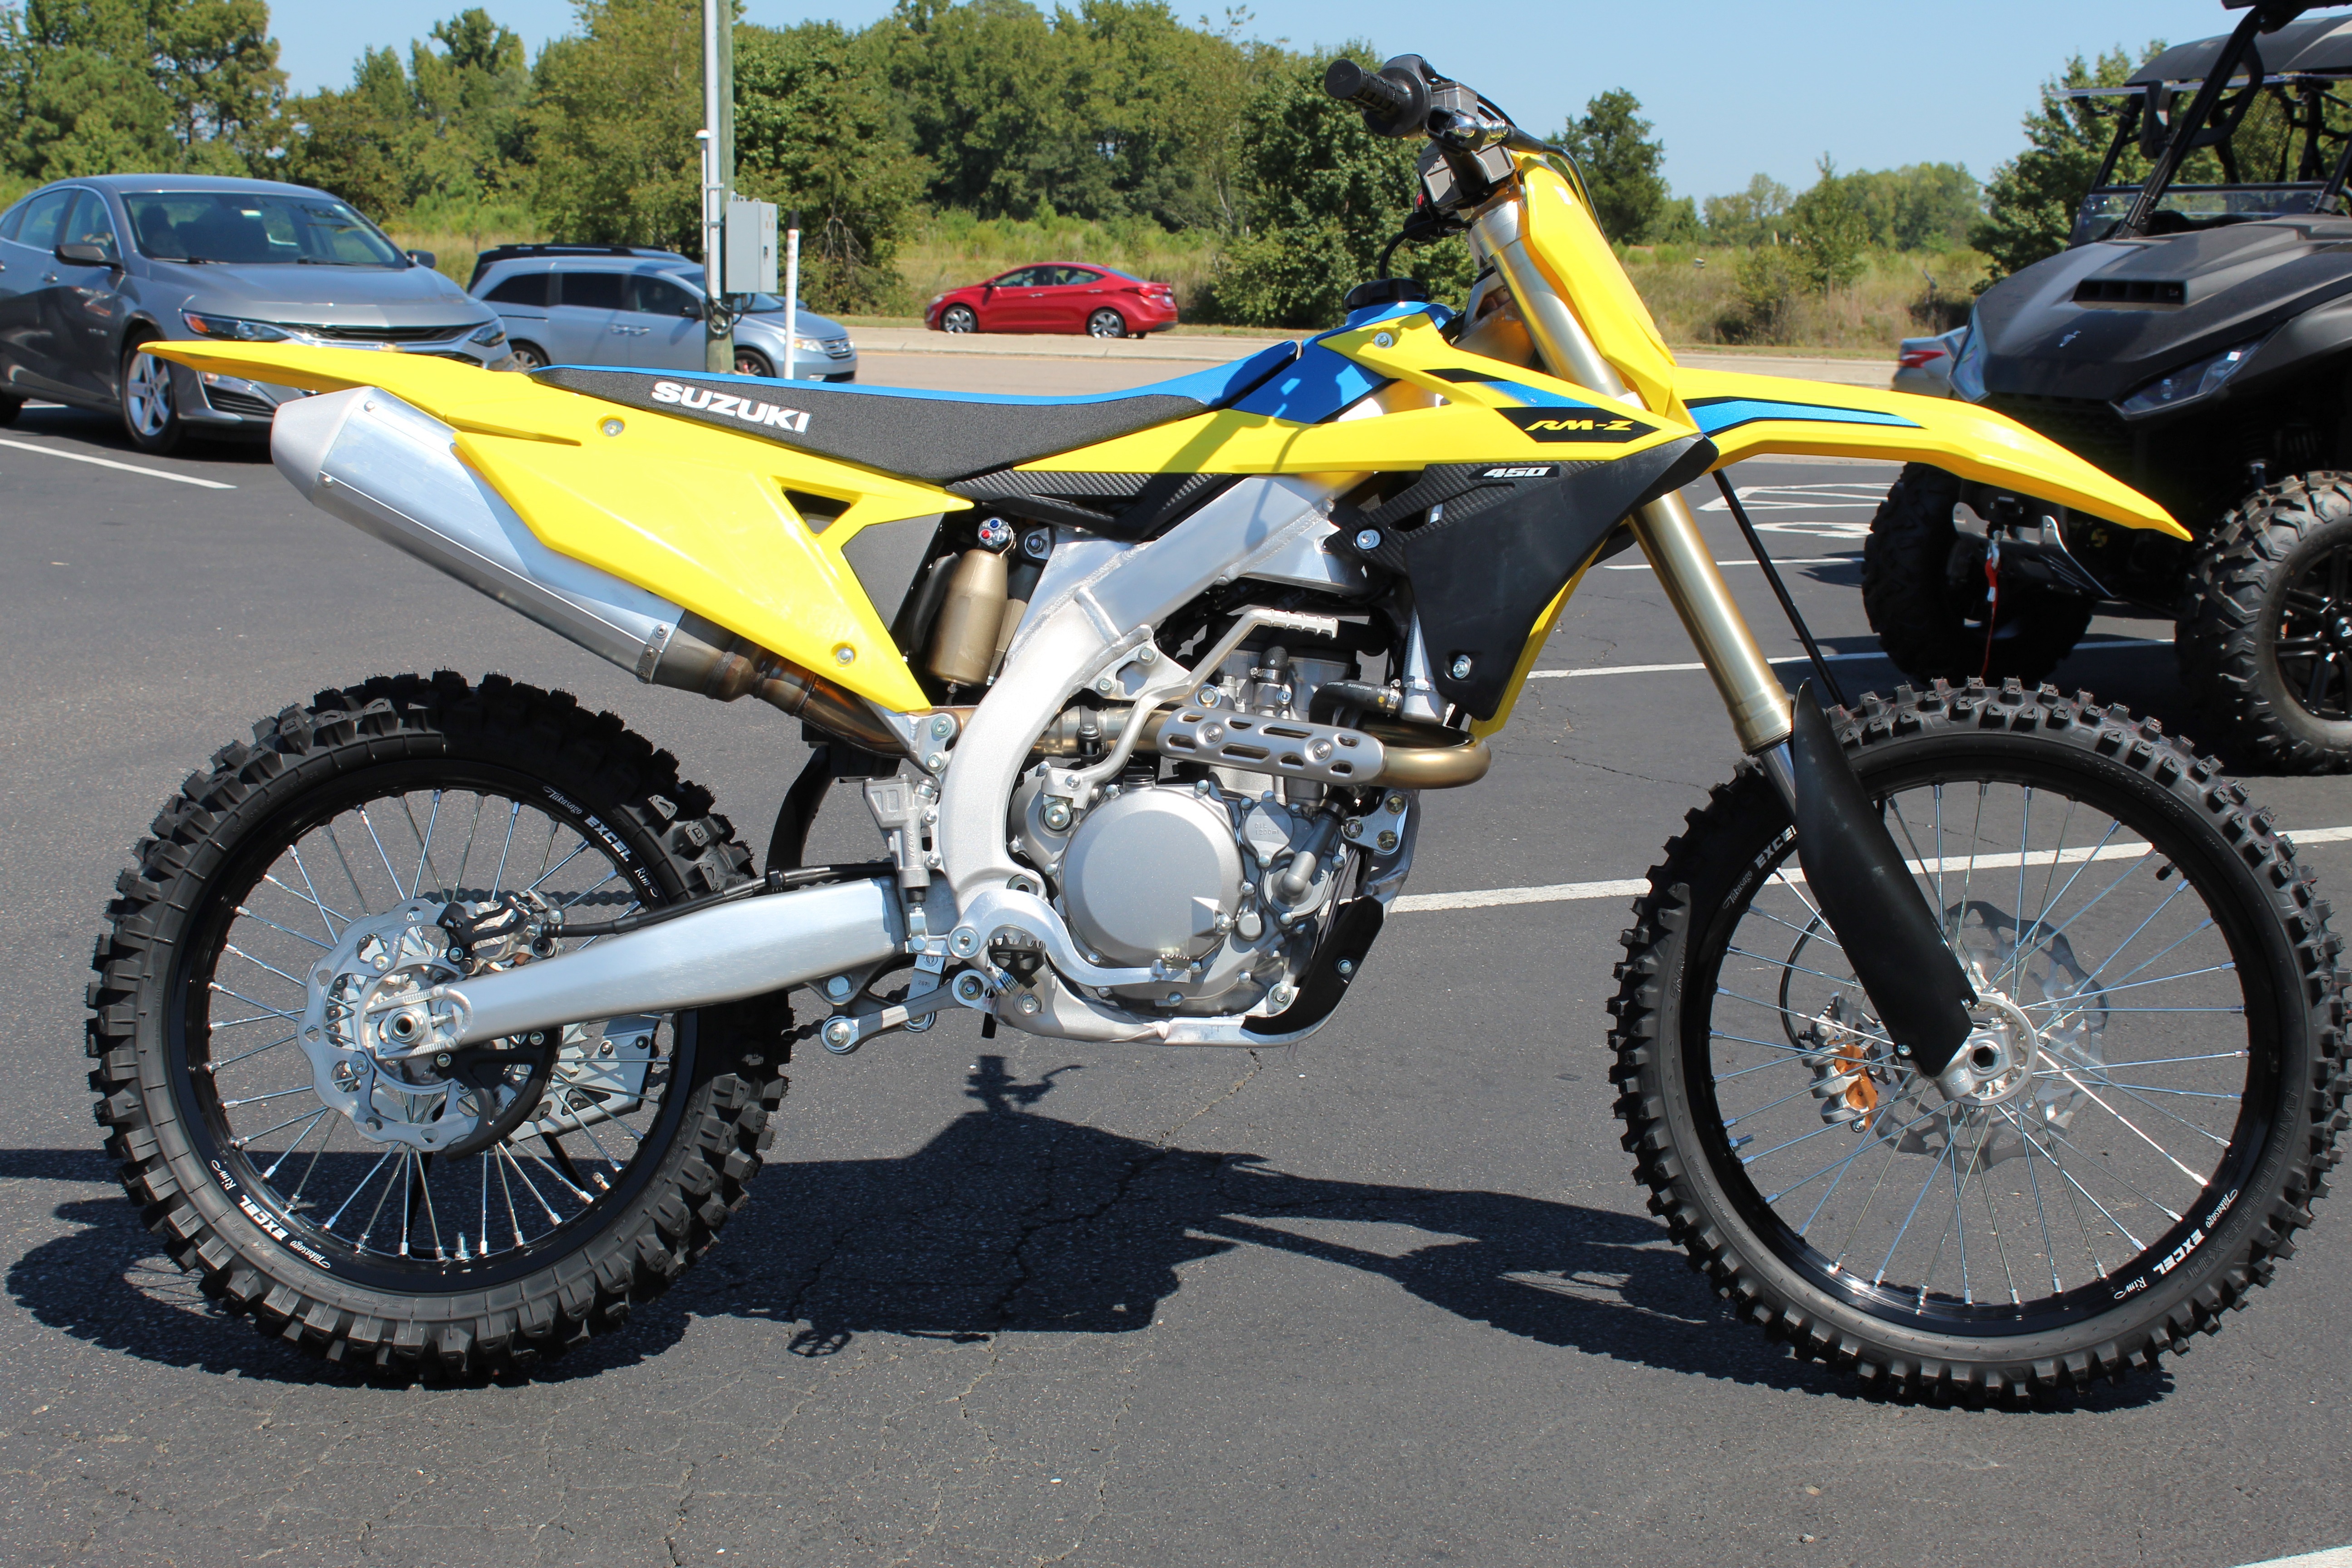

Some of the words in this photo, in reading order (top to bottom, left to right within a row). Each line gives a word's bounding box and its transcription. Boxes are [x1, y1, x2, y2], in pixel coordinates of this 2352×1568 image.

[652, 380, 810, 434] SUZUKI
[1524, 420, 1635, 431] RM-Z
[1483, 466, 1552, 478] 450
[543, 786, 583, 815] Takasago
[584, 815, 633, 862] EXCEL
[634, 867, 658, 897] Rim
[1722, 870, 1753, 909] Takasago
[211, 1159, 236, 1191] Rim
[239, 1194, 289, 1241] EXCEL
[2205, 1189, 2238, 1228] Takasago
[289, 1240, 331, 1269] Takasago
[2153, 1229, 2205, 1276] EXCEL
[2114, 1276, 2147, 1299] Rim
